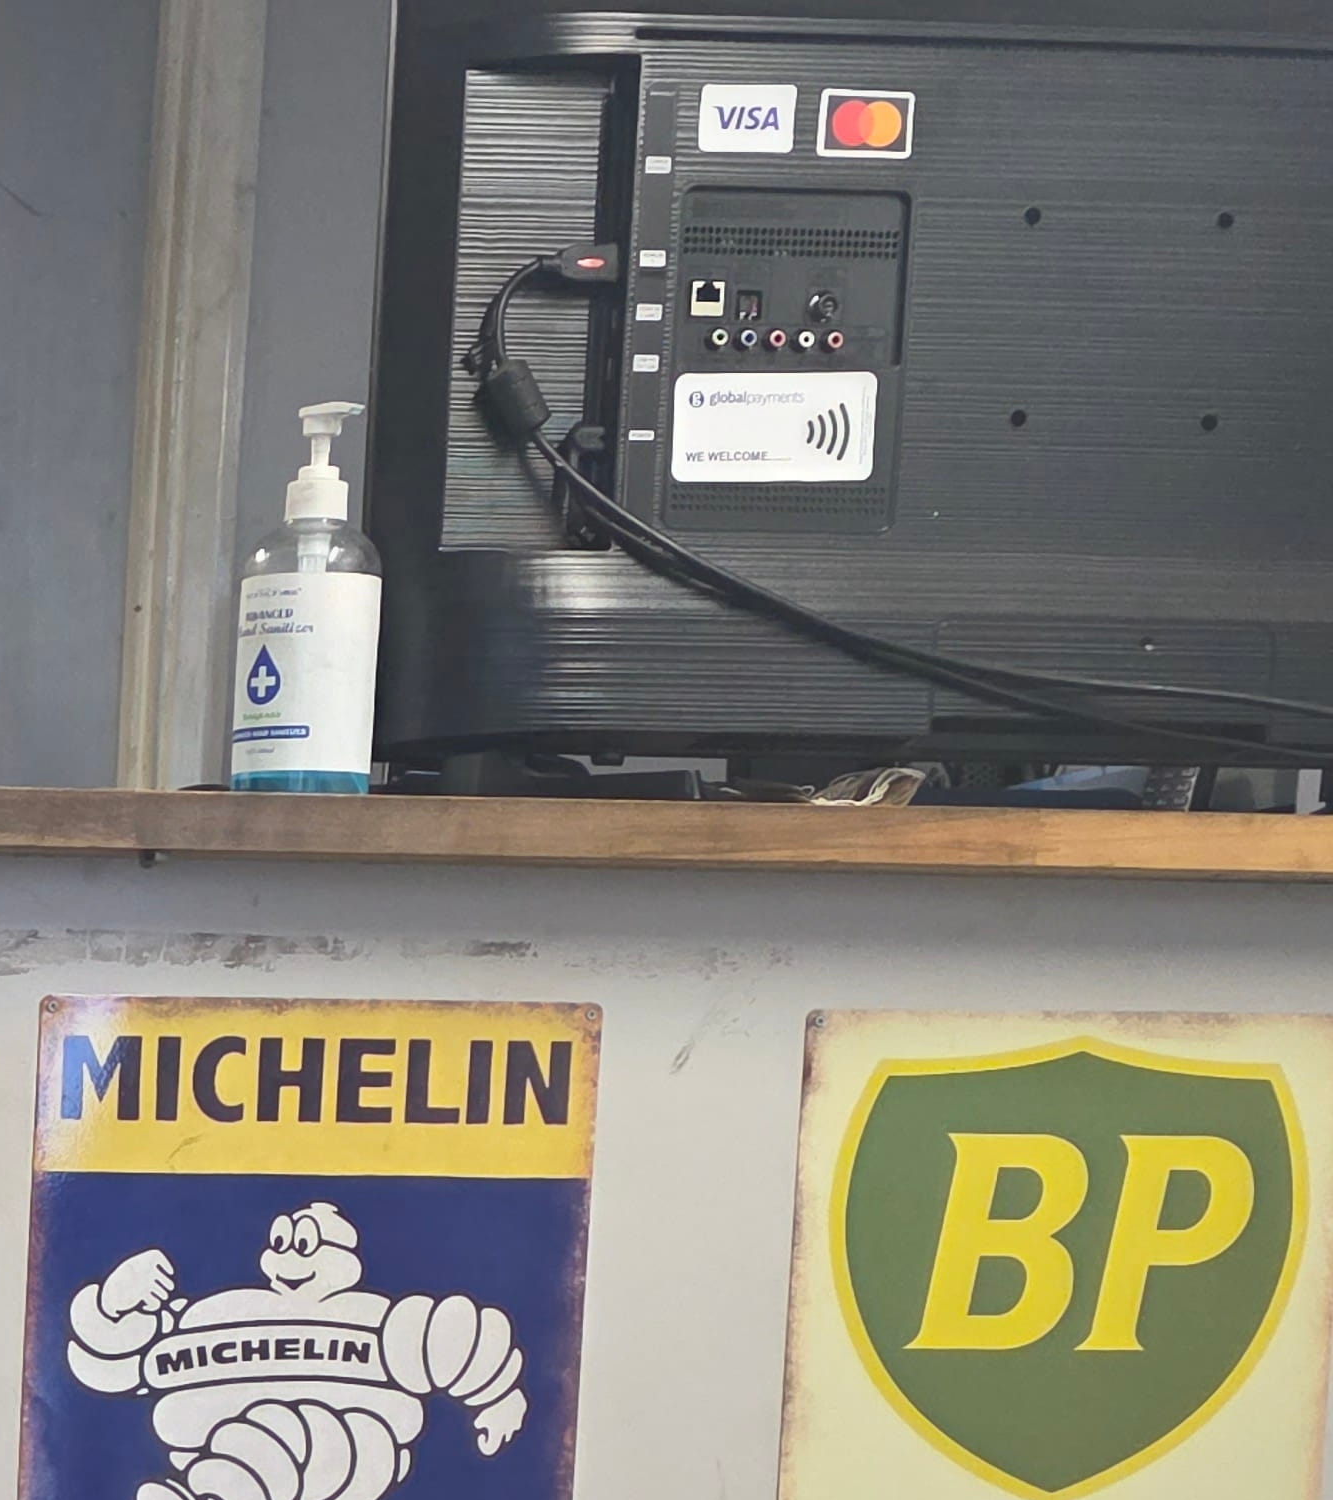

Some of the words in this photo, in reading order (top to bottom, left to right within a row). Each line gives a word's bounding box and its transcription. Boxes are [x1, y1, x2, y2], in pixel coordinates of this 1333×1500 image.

[713, 106, 780, 131] VISA
[685, 451, 705, 462] WE
[60, 1033, 571, 1126] MICHELIN
[903, 1132, 1255, 1352] BP
[155, 1337, 371, 1377] MICHELIN
